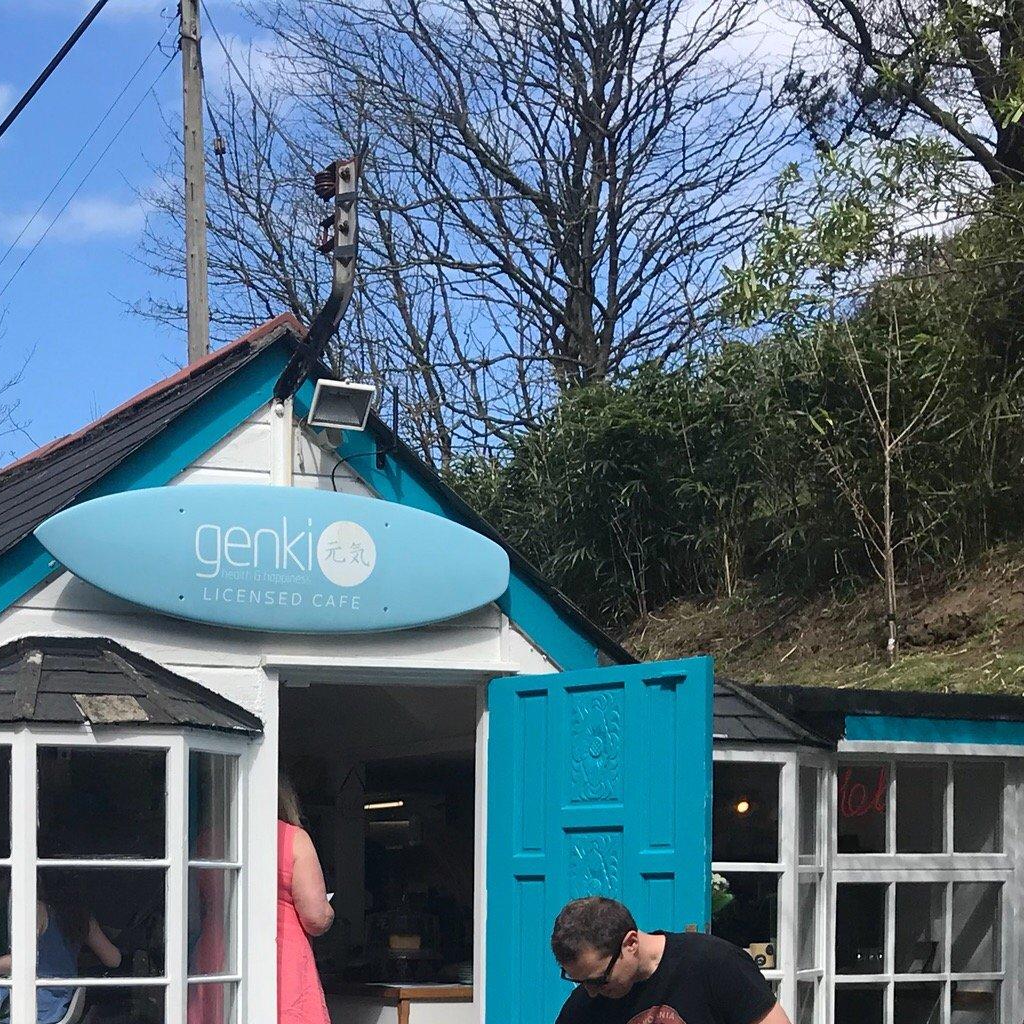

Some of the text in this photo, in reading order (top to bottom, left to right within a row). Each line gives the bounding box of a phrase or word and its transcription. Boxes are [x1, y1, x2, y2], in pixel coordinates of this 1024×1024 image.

[194, 516, 313, 579] genki
[203, 587, 361, 609] LICENSED CAFE
